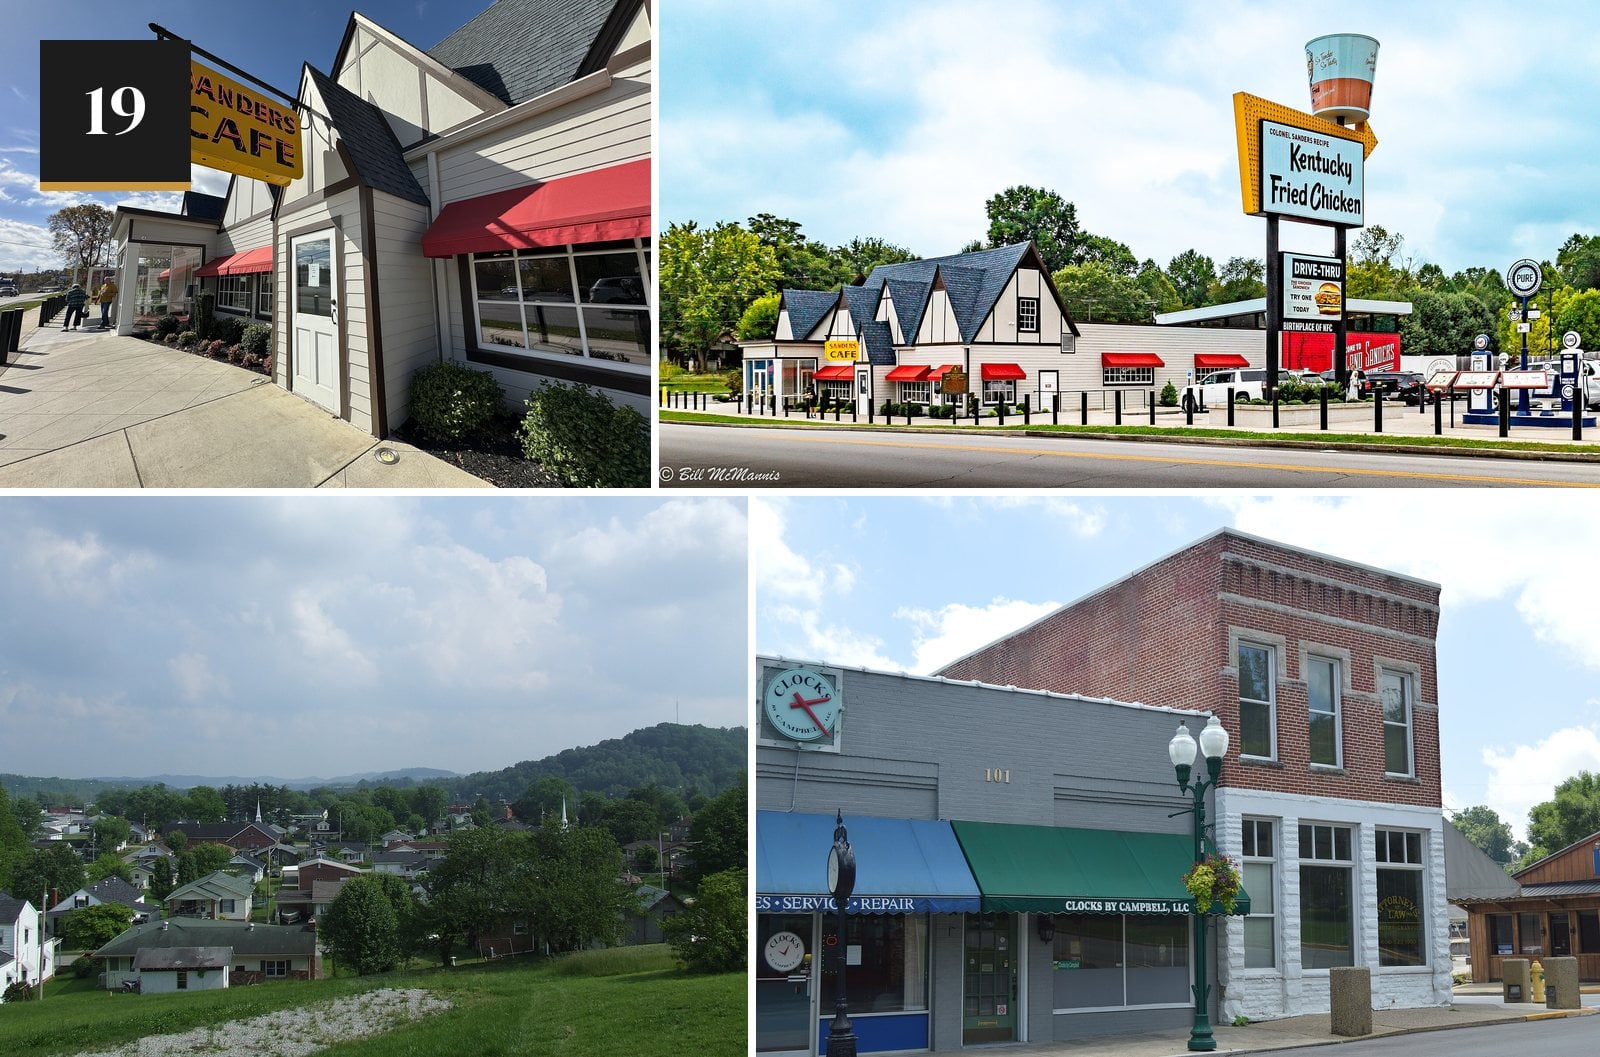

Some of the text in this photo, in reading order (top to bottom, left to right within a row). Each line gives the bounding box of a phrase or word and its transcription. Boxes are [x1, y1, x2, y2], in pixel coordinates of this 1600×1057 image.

[191, 72, 296, 135] ANDERS
[1269, 127, 1330, 148] COLONEL SANDERS RECIPE
[1290, 142, 1352, 185] Kentucky
[1270, 174, 1361, 214] Fried Chicken
[1294, 261, 1341, 278] DRIVE-THRU
[1516, 273, 1534, 283] PURE
[1283, 321, 1315, 332] BIRTHPLACE
[1315, 323, 1323, 332] OF
[830, 350, 857, 359] CAFE
[1365, 341, 1395, 367] SANDERS
[984, 768, 1011, 784] 101
[782, 896, 850, 910] SERVIC
[861, 897, 915, 910] REPAIR
[1065, 900, 1190, 913] CLOCKS BY CAMPBELL, LLC
[1388, 909, 1406, 919] LAW
[769, 934, 801, 949] CLOCKS
